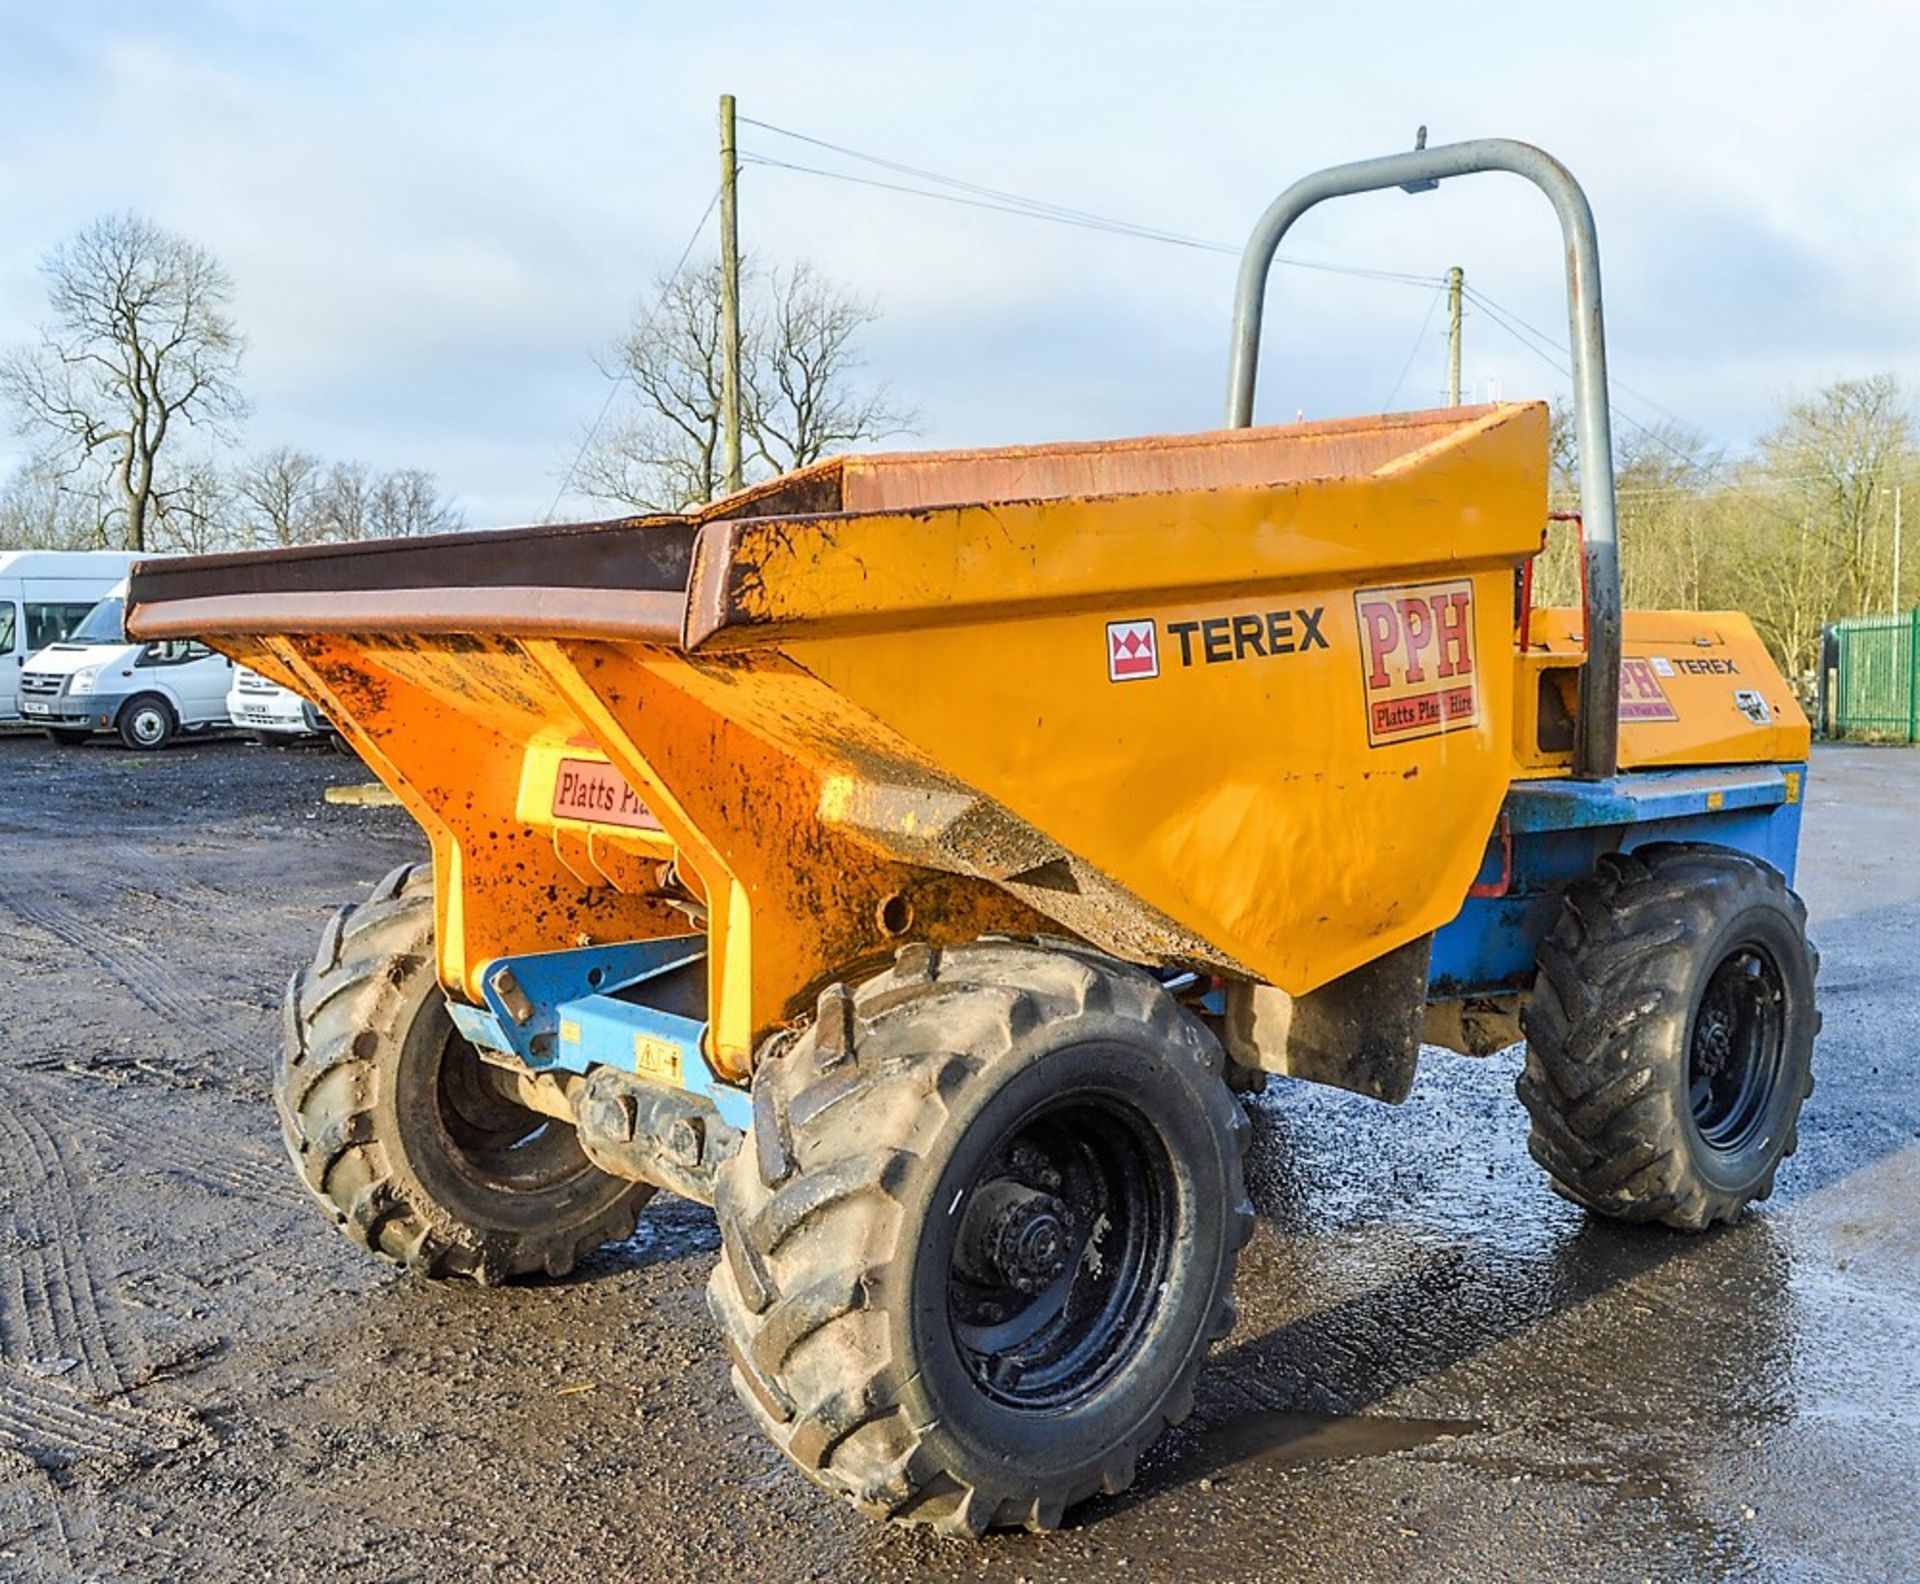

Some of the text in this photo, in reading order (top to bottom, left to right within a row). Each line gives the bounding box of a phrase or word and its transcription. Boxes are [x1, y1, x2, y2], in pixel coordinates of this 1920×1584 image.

[1167, 606, 1330, 667] TEREX
[1361, 591, 1473, 690] PPH
[1619, 661, 1663, 699] PH
[1671, 658, 1741, 675] TEREX
[1375, 694, 1472, 729] Platts Plan Hire
[558, 772, 615, 811] Platts
